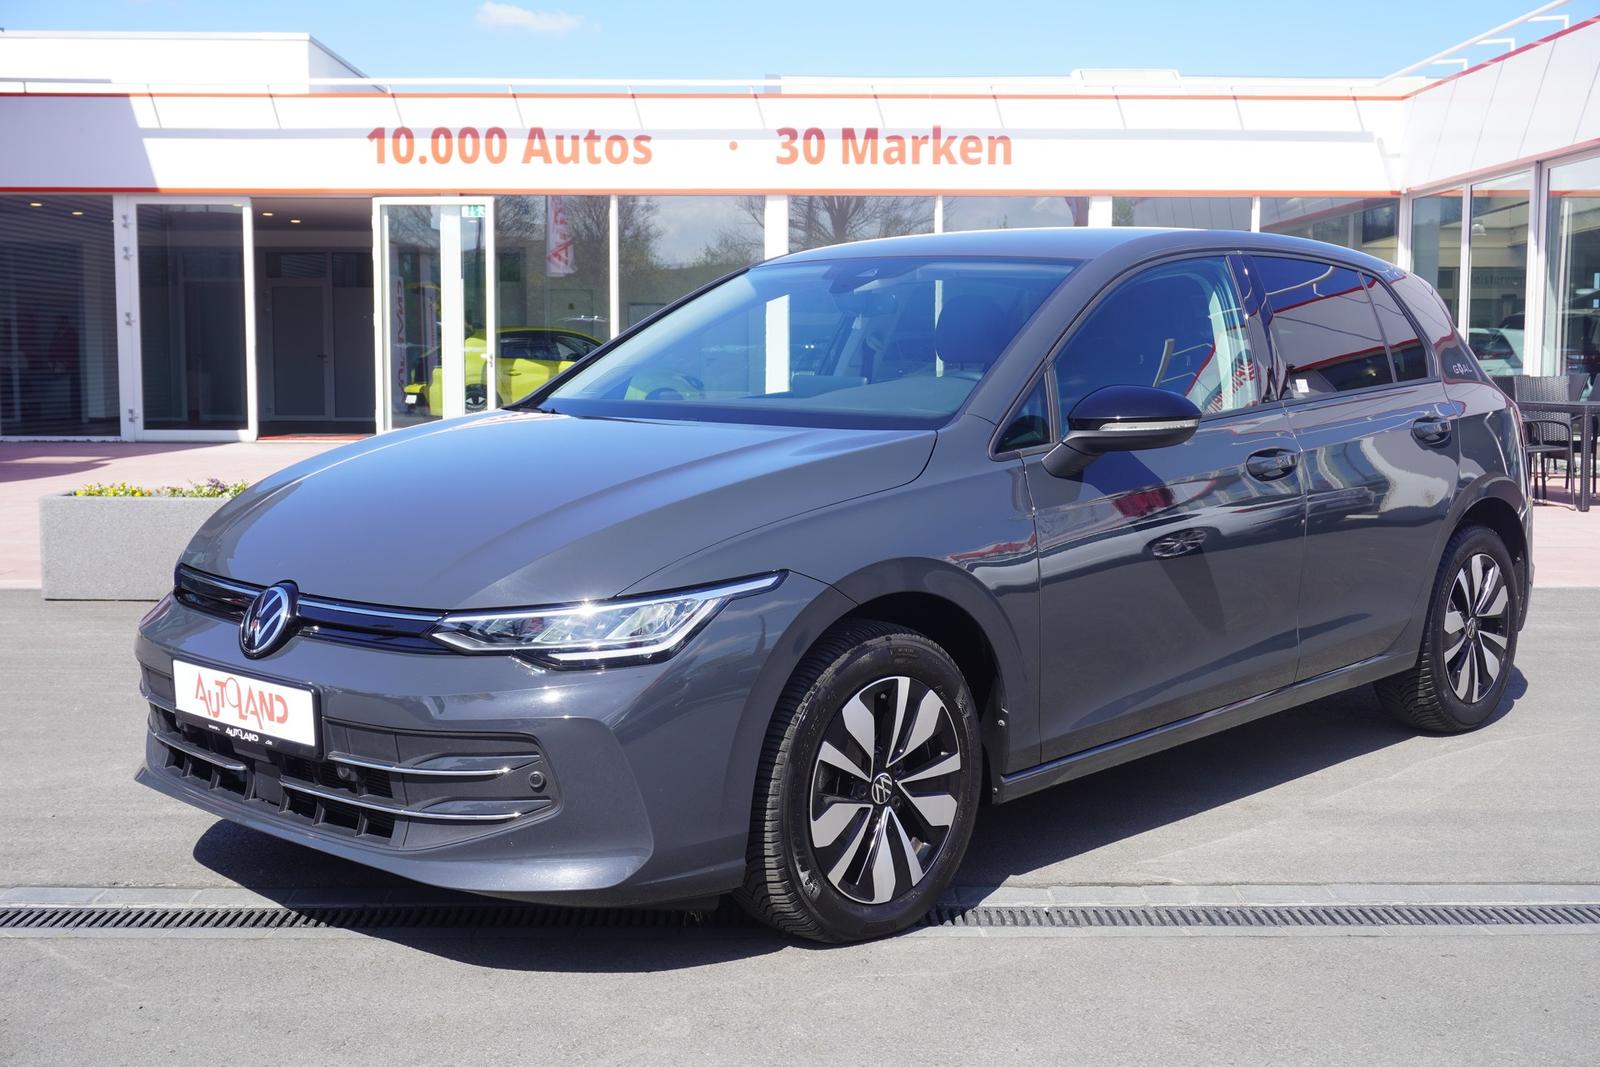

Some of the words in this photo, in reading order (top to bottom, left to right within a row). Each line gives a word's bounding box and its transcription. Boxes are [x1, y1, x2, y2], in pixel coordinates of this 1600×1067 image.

[366, 126, 508, 165] 10.000
[521, 126, 653, 165] Autos
[775, 127, 826, 165] 30
[841, 125, 1013, 166] Marken
[195, 672, 289, 730] AUTOLAND
[225, 726, 260, 742] AUTOLAND
